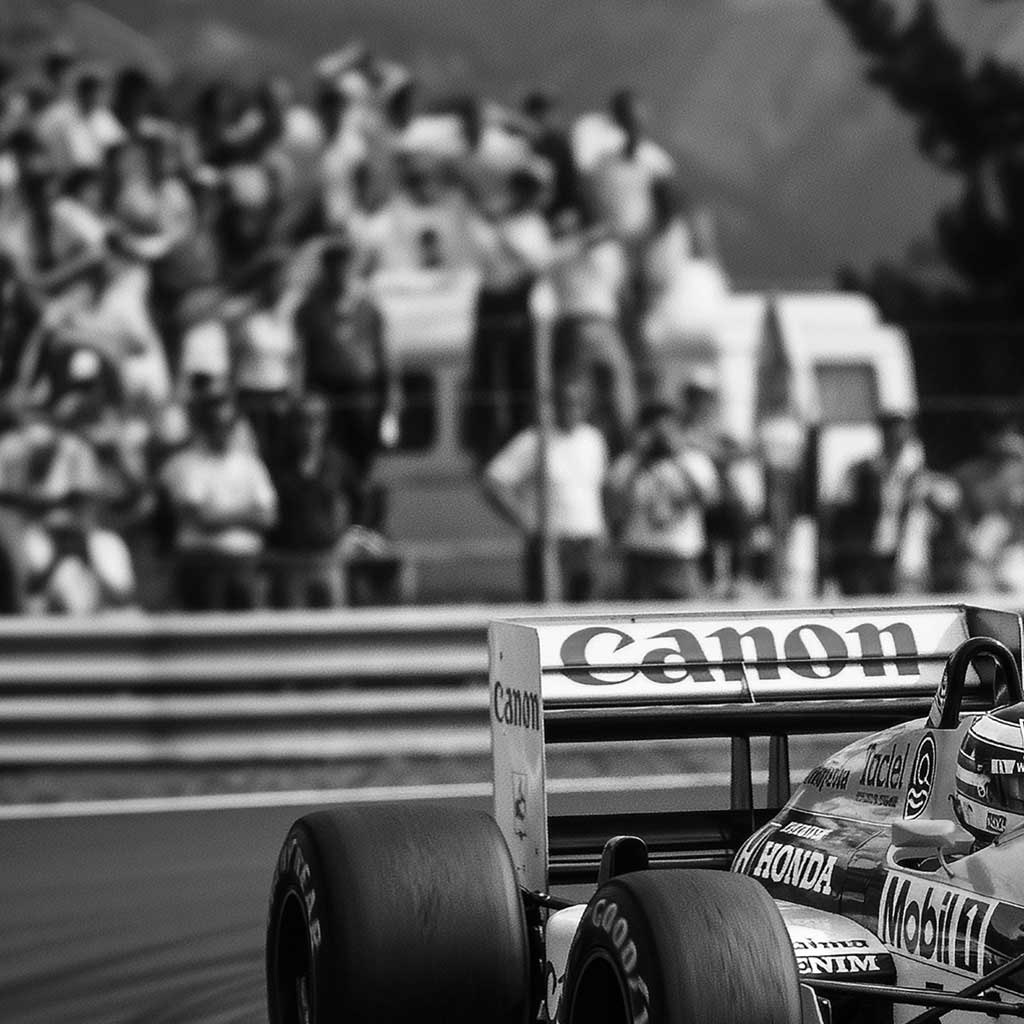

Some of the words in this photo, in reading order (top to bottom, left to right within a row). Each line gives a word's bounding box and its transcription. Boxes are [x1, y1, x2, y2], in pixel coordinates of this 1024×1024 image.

[559, 622, 921, 686] Canon
[494, 681, 540, 731] Canon
[753, 841, 838, 896] HONDA
[883, 875, 960, 965] Mobil
